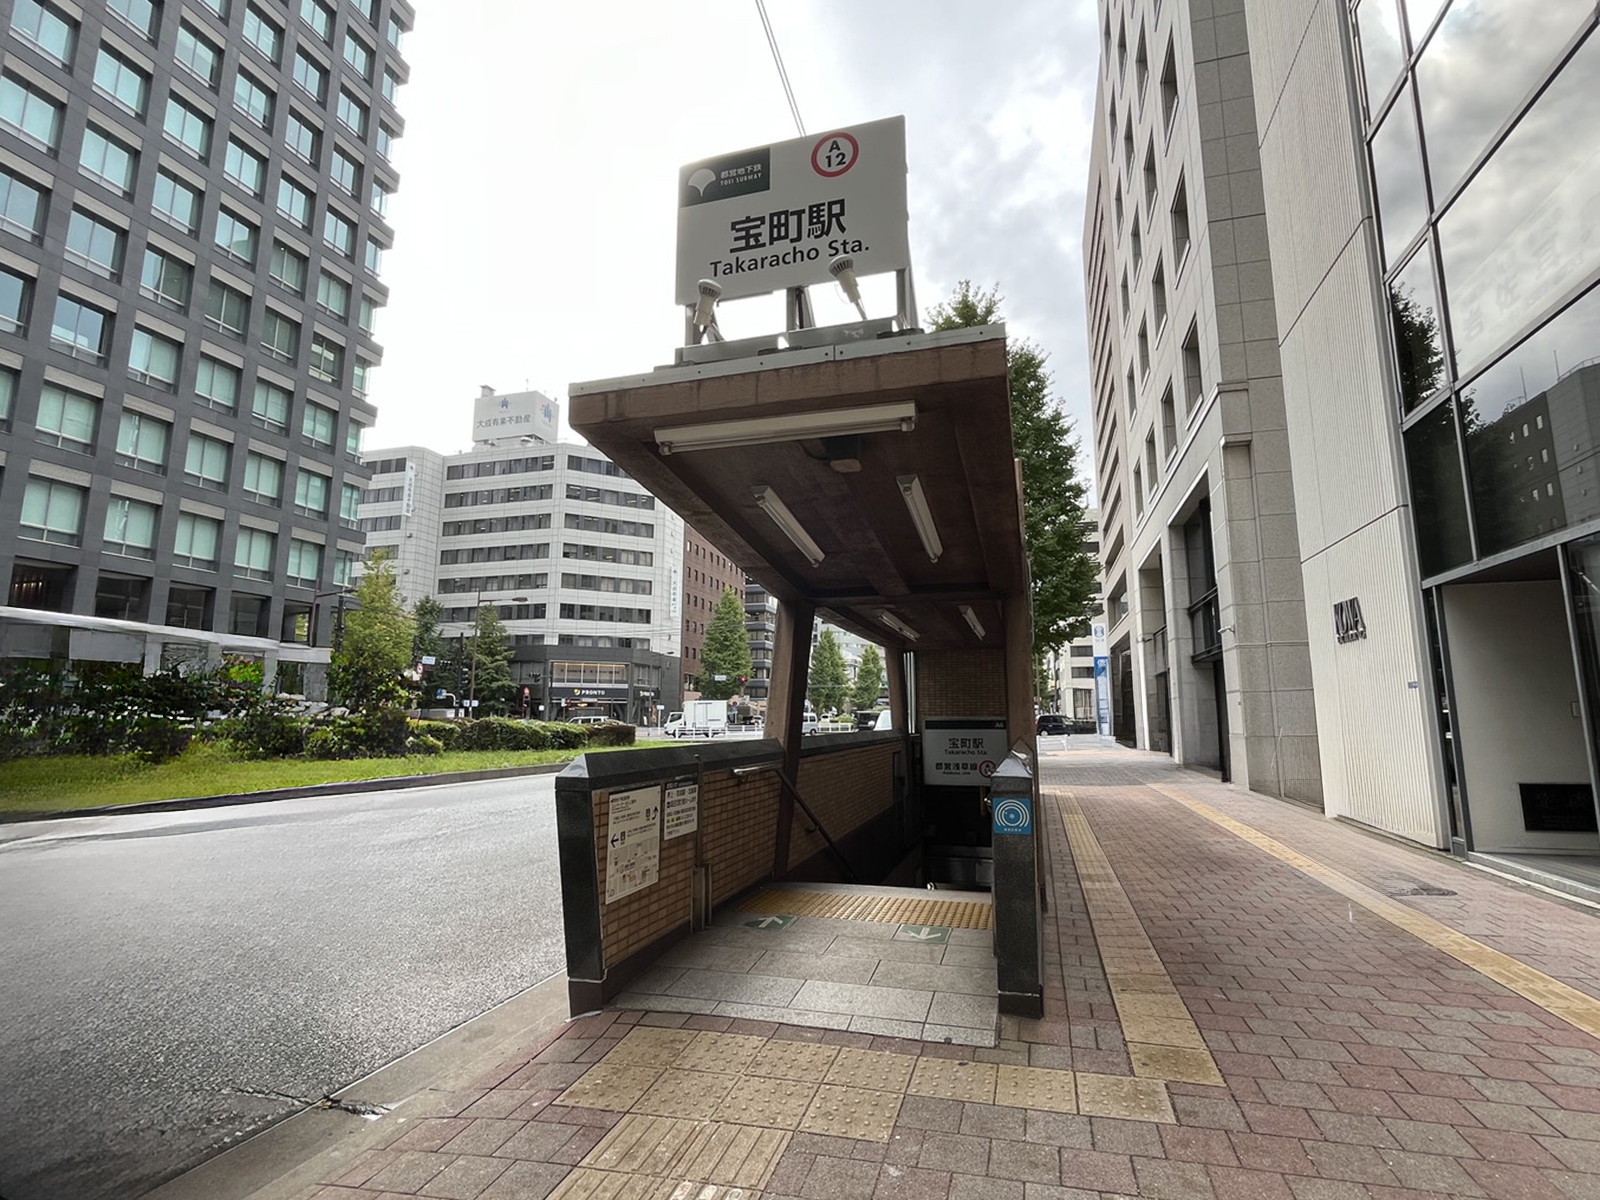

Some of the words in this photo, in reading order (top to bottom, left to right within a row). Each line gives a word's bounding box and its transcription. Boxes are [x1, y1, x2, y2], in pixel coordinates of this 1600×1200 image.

[829, 140, 841, 153] A
[825, 153, 846, 168] 12
[720, 164, 761, 178] 都営地下鉄
[720, 178, 734, 186] TOEI
[736, 173, 762, 183] SUBWAY
[730, 199, 846, 253] 宝町駅
[710, 246, 820, 278] Takaracho
[828, 238, 870, 257] Sta.
[948, 738, 984, 749] 宝町駅
